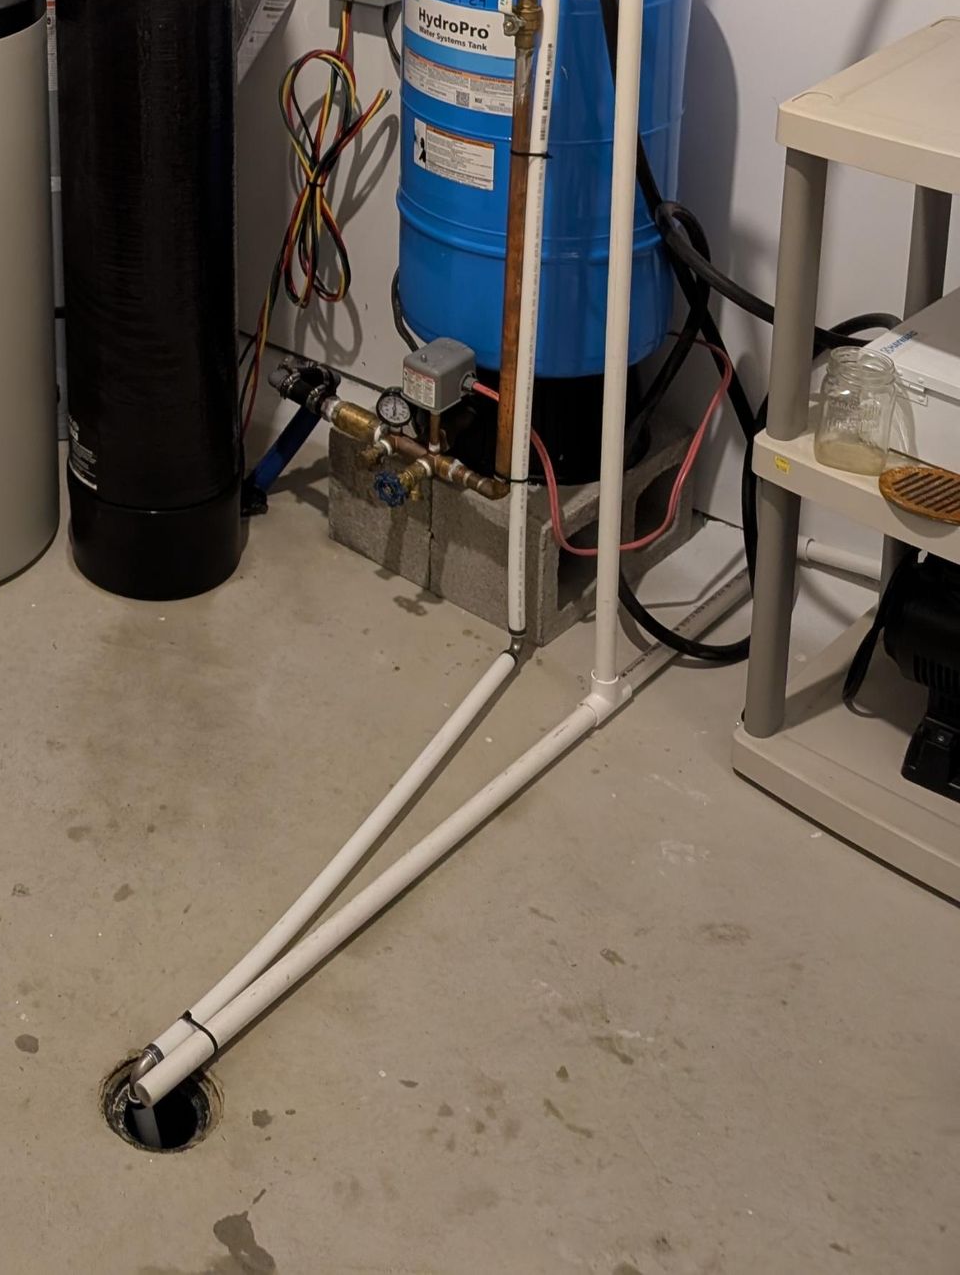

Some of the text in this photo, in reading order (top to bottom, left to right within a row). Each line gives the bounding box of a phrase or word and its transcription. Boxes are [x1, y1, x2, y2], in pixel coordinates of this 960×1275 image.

[418, 6, 489, 39] HydroPro
[419, 25, 488, 51] Water Systems Tank
